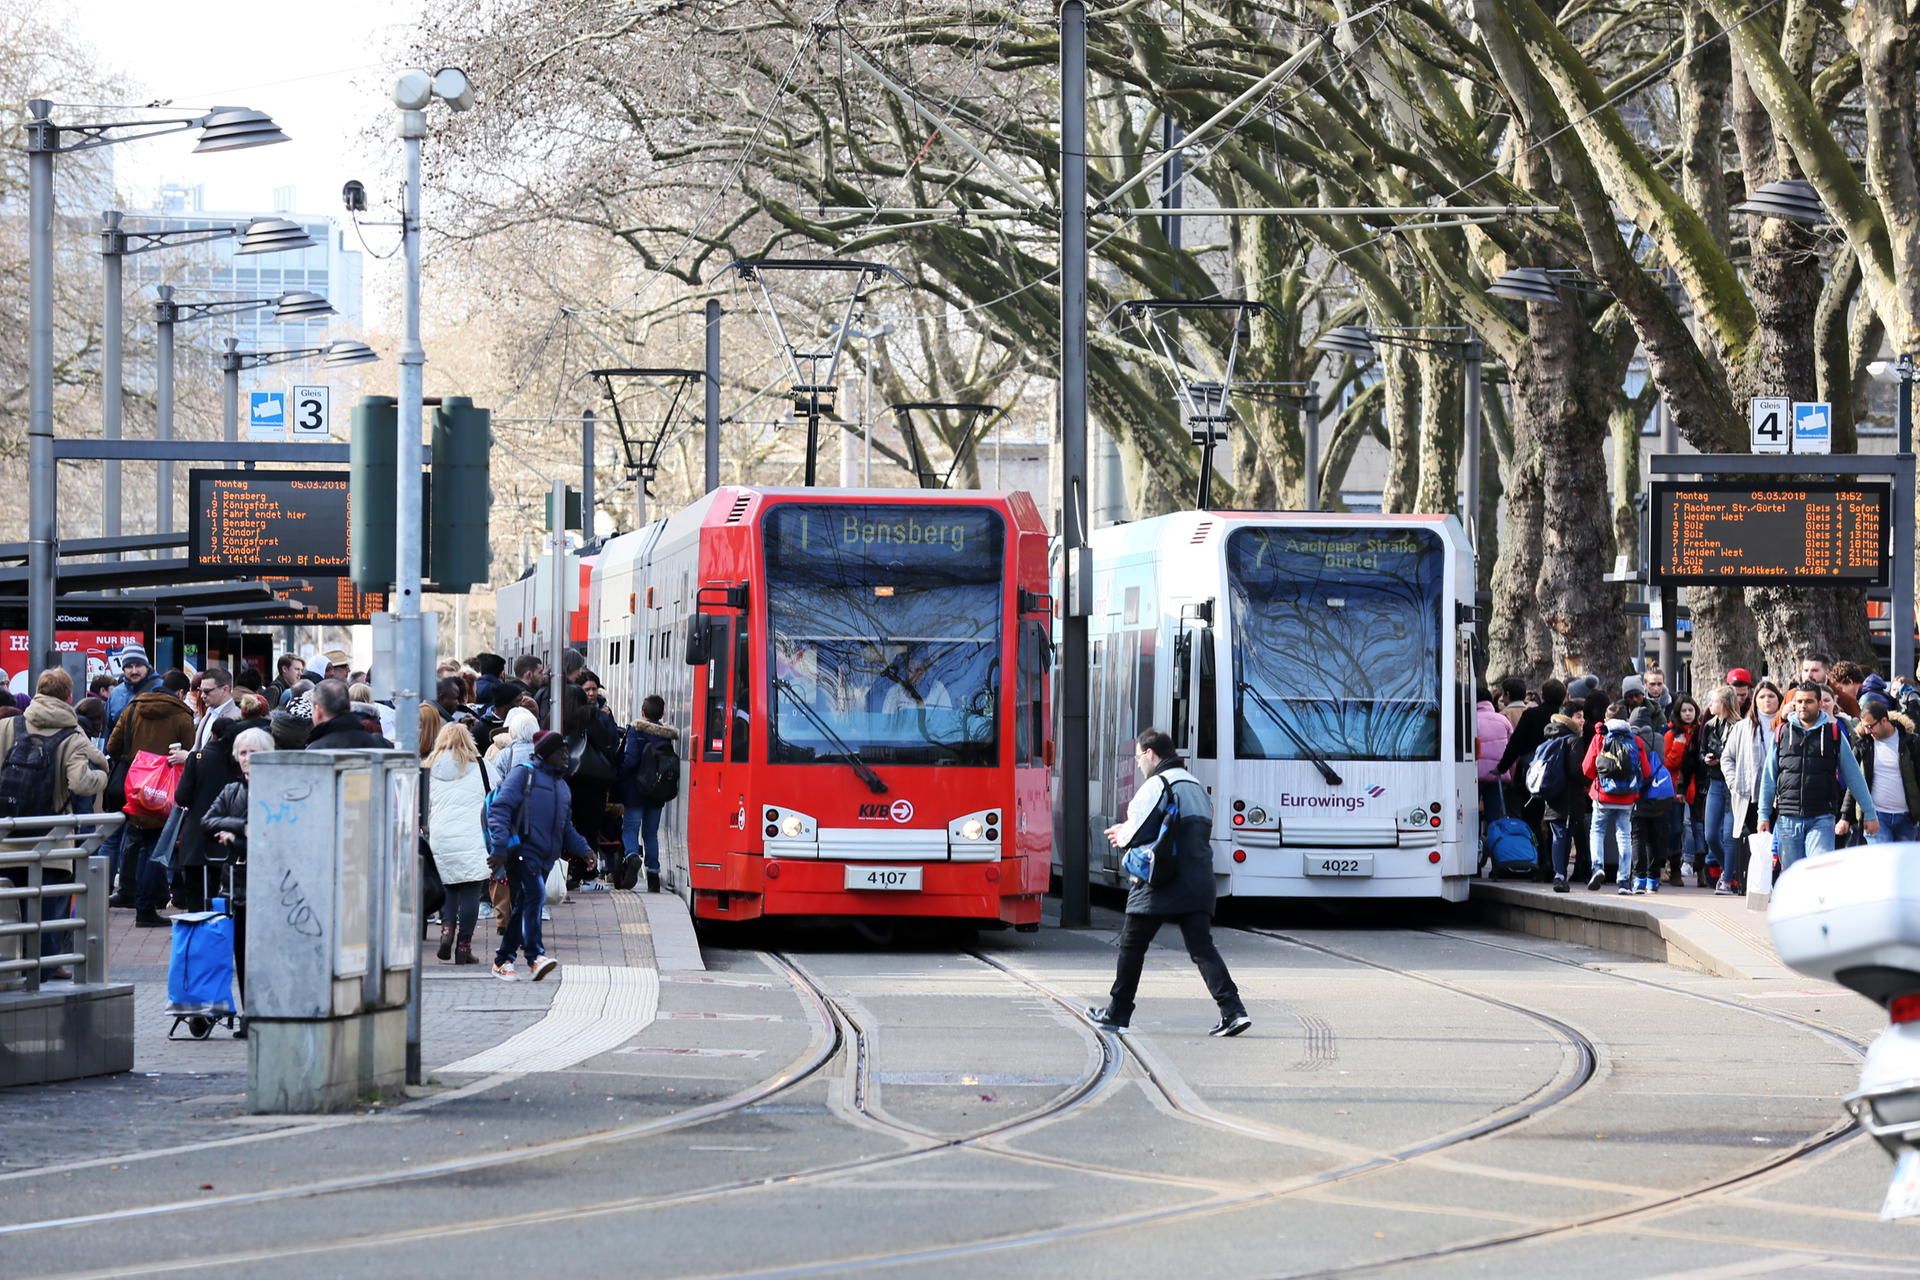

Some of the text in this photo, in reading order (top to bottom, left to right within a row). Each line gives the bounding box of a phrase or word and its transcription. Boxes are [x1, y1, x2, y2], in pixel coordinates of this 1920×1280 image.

[301, 389, 321, 397] Gleis
[1760, 402, 1780, 410] Gleis
[300, 400, 322, 430] 3
[1758, 412, 1782, 440] 4
[214, 480, 248, 490] Montag
[212, 491, 266, 502] 1 Bensberg
[1676, 492, 1862, 502] Montag 05.03.2018 13:52
[212, 500, 279, 512] 9 Königsforst
[1673, 503, 1679, 512] 7
[1684, 503, 1726, 512] Aachener
[1806, 504, 1830, 512] Gleis
[1836, 504, 1842, 512] 4
[1849, 504, 1880, 514] Sofort
[206, 509, 306, 519] 16 Fahrt endet hier
[1673, 512, 1678, 520] 1
[1684, 512, 1716, 520] Weiden
[1722, 512, 1744, 521] West
[1806, 513, 1830, 521] Gleis
[1836, 513, 1842, 521] 4
[212, 519, 266, 529] 1 Bensberg
[1672, 521, 1678, 530] 9
[800, 515, 964, 552] 1 Bensberg
[1672, 530, 1678, 538] 9
[1806, 531, 1830, 539] Gleis
[1836, 531, 1842, 539] 4
[222, 537, 279, 547] Königsforst
[1683, 539, 1721, 548] Frechen
[1806, 540, 1830, 548] Gleis
[1836, 540, 1841, 548] 4
[1850, 540, 1861, 548] 18
[1862, 540, 1879, 548] Min
[211, 545, 217, 554] 7
[1254, 538, 1417, 568] 7 Aachener Straße
[1673, 548, 1678, 556] 1
[1683, 548, 1715, 556] Weiden
[1721, 548, 1743, 557] West
[1806, 548, 1830, 557] Gleis
[1836, 548, 1841, 557] 4
[278, 555, 292, 564] (H)
[297, 556, 308, 566] Bf
[1325, 552, 1377, 568] Gürtel
[1806, 558, 1830, 566] Gleis
[1836, 558, 1841, 566] 4
[1849, 558, 1861, 566] 23
[1862, 558, 1879, 566] Min
[1672, 566, 1703, 574] 14:13h
[1720, 566, 1734, 574] (H)
[1740, 566, 1788, 574] Moltkestr.
[1794, 566, 1826, 574] 14:18h
[96, 636, 117, 644] NUR
[1281, 793, 1365, 811] Eurowings
[858, 804, 890, 817] KVB
[1322, 860, 1358, 871] 4022
[868, 872, 907, 884] 4107
